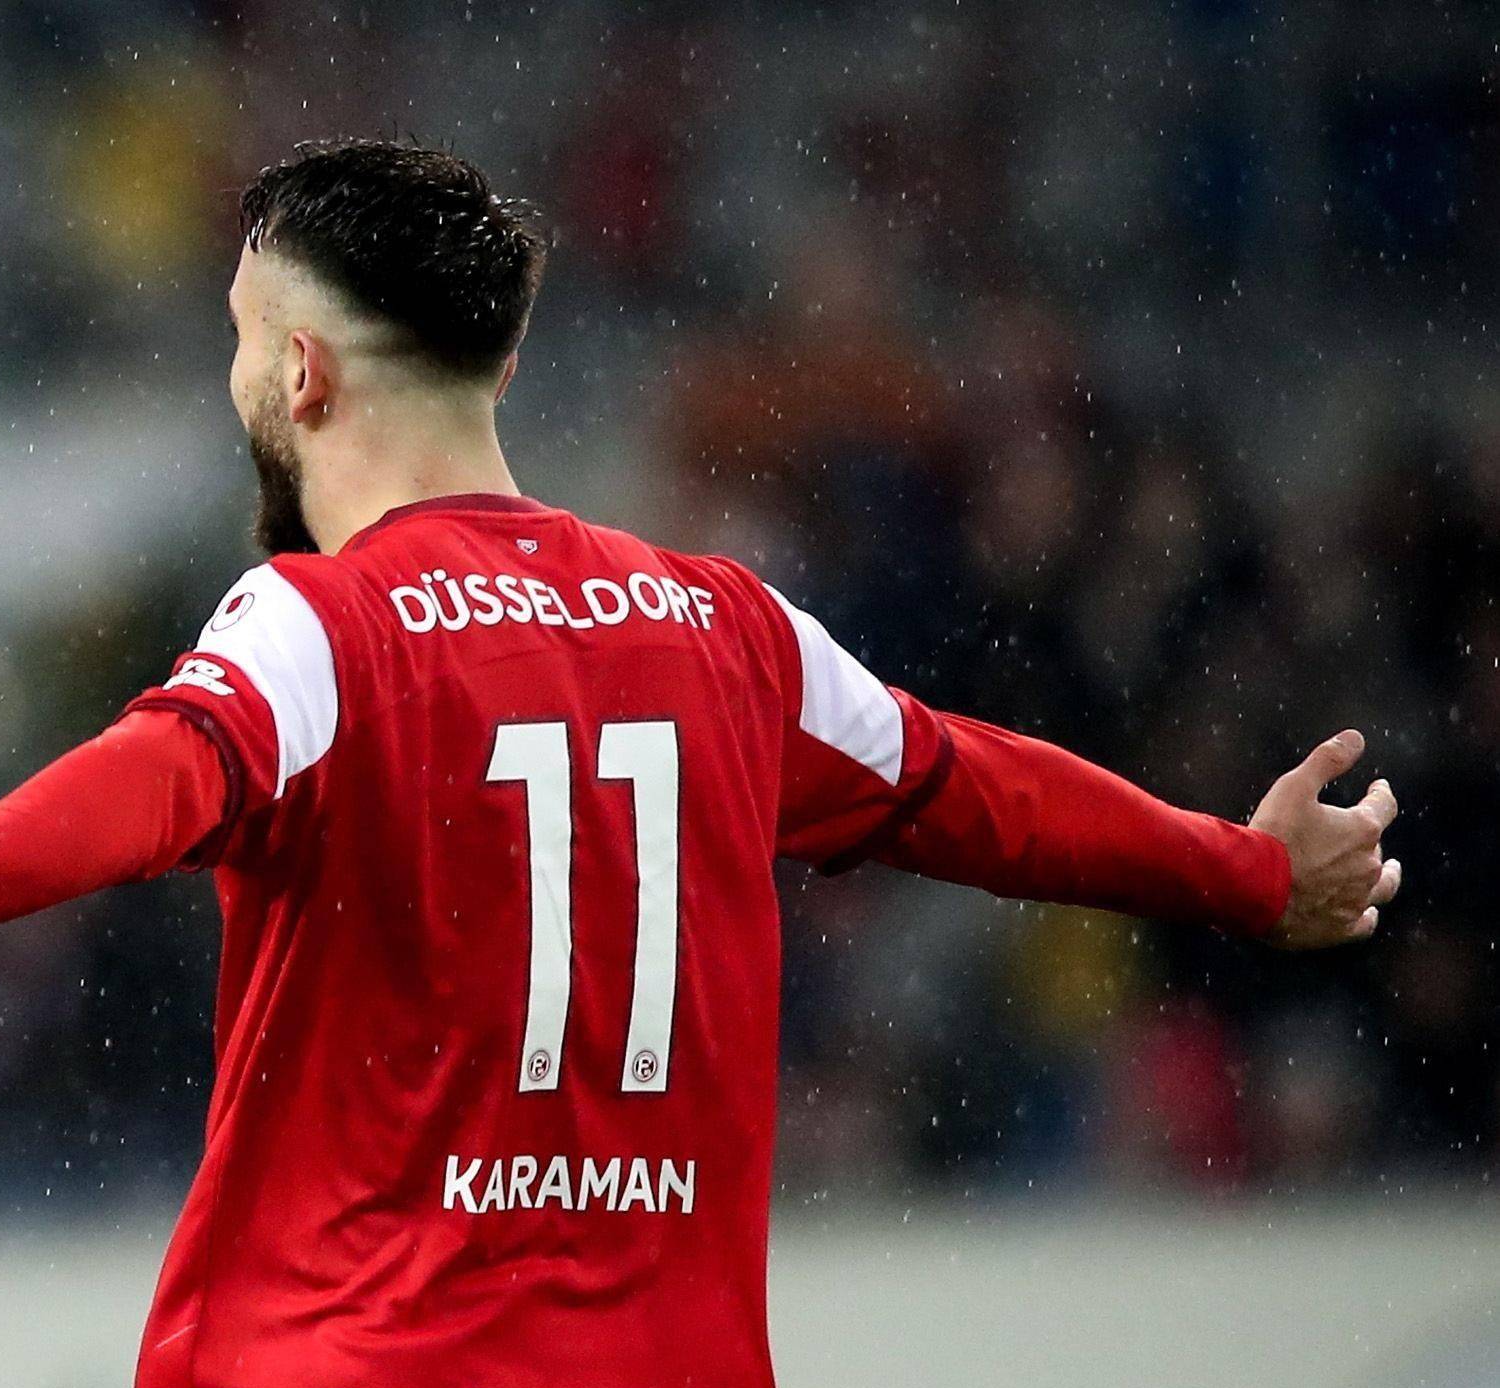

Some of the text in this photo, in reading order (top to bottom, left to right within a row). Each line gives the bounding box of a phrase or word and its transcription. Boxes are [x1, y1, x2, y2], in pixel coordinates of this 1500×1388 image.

[388, 568, 715, 634] DÜSSELDORF
[486, 720, 681, 1093] 11
[443, 1155, 696, 1215] KARAMAN
